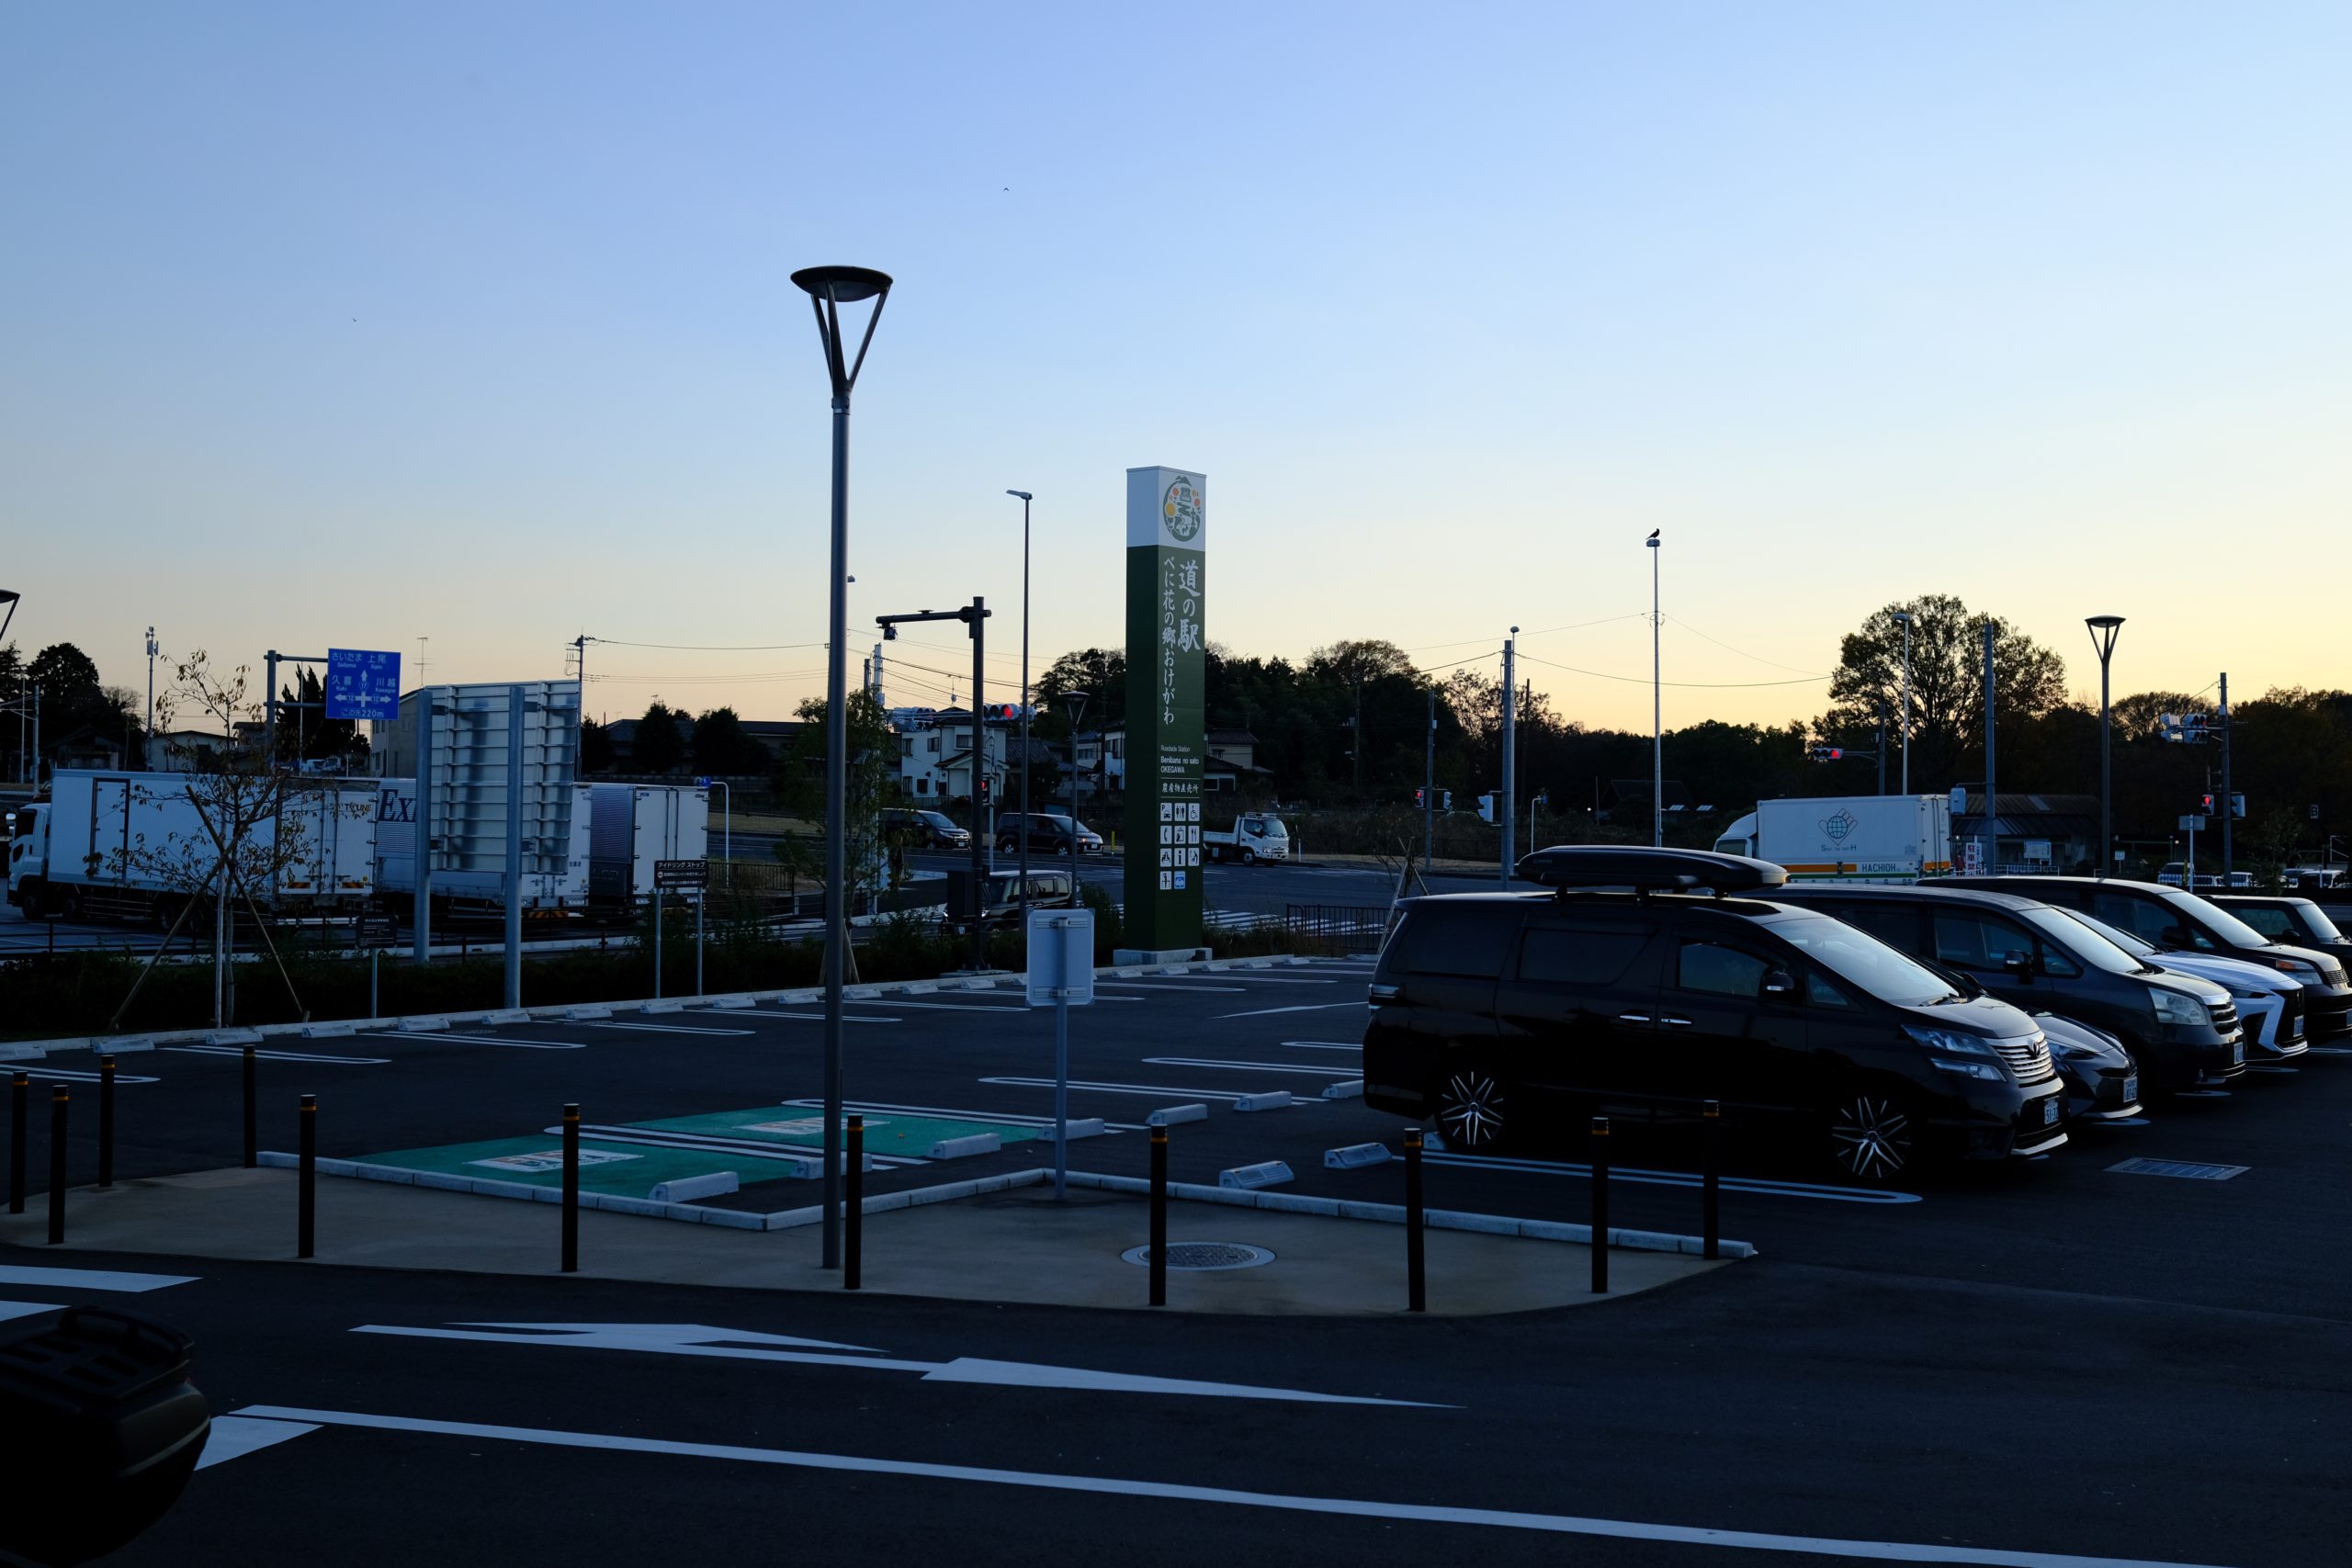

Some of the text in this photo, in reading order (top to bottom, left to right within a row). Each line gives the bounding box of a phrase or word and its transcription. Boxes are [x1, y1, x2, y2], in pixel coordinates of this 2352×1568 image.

[1178, 559, 1201, 653] 道の駅
[1162, 556, 1176, 726] べに花の郷おけがわ
[332, 652, 362, 661] さいたま
[1160, 756, 1181, 764] Benibana
[1190, 757, 1200, 765] sato
[1160, 765, 1185, 773] OKEGAWA
